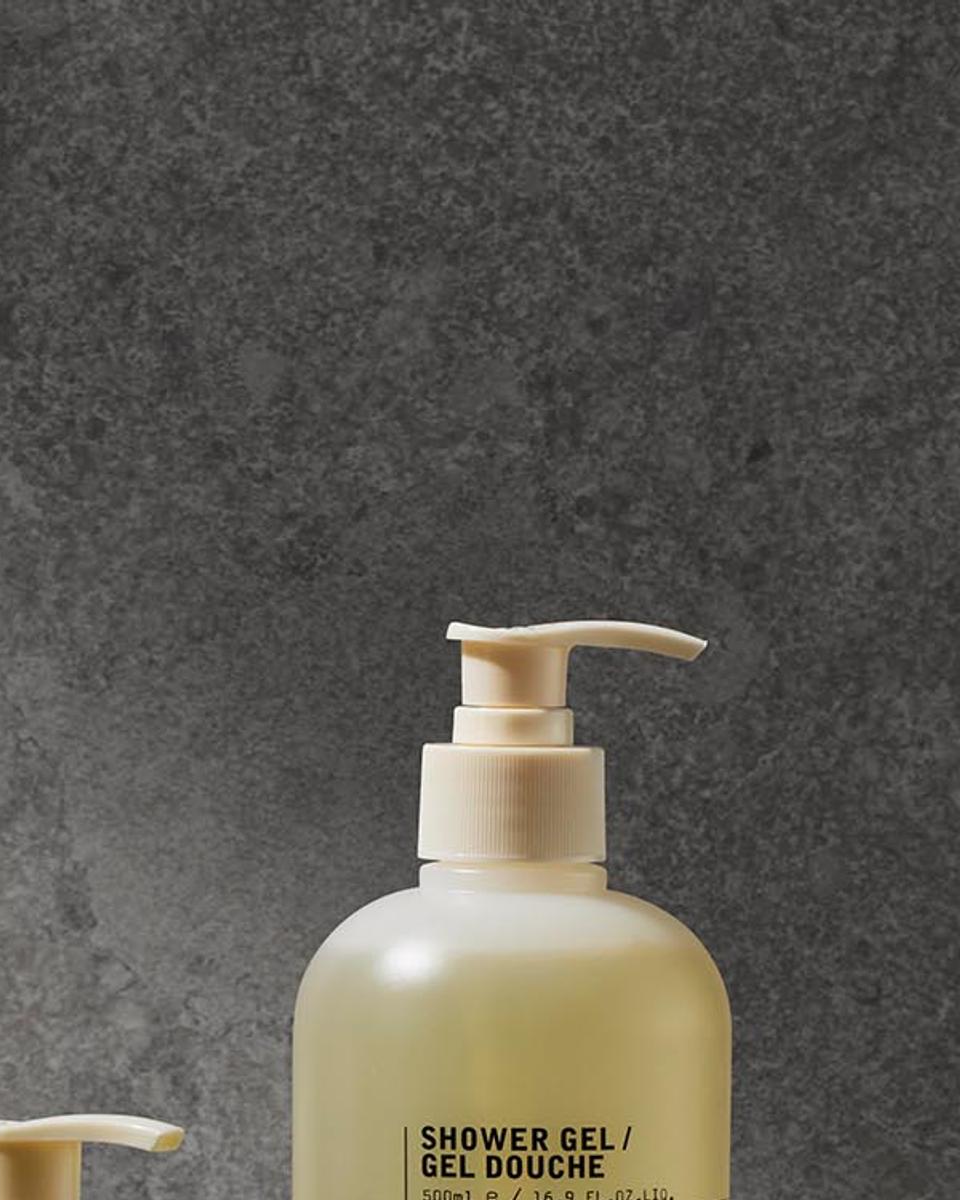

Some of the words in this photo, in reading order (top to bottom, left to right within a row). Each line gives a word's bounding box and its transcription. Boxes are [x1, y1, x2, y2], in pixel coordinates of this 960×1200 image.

[421, 1125, 548, 1151] SHOWER
[421, 1153, 475, 1178] GEL
[486, 1154, 605, 1180] DOUCHE
